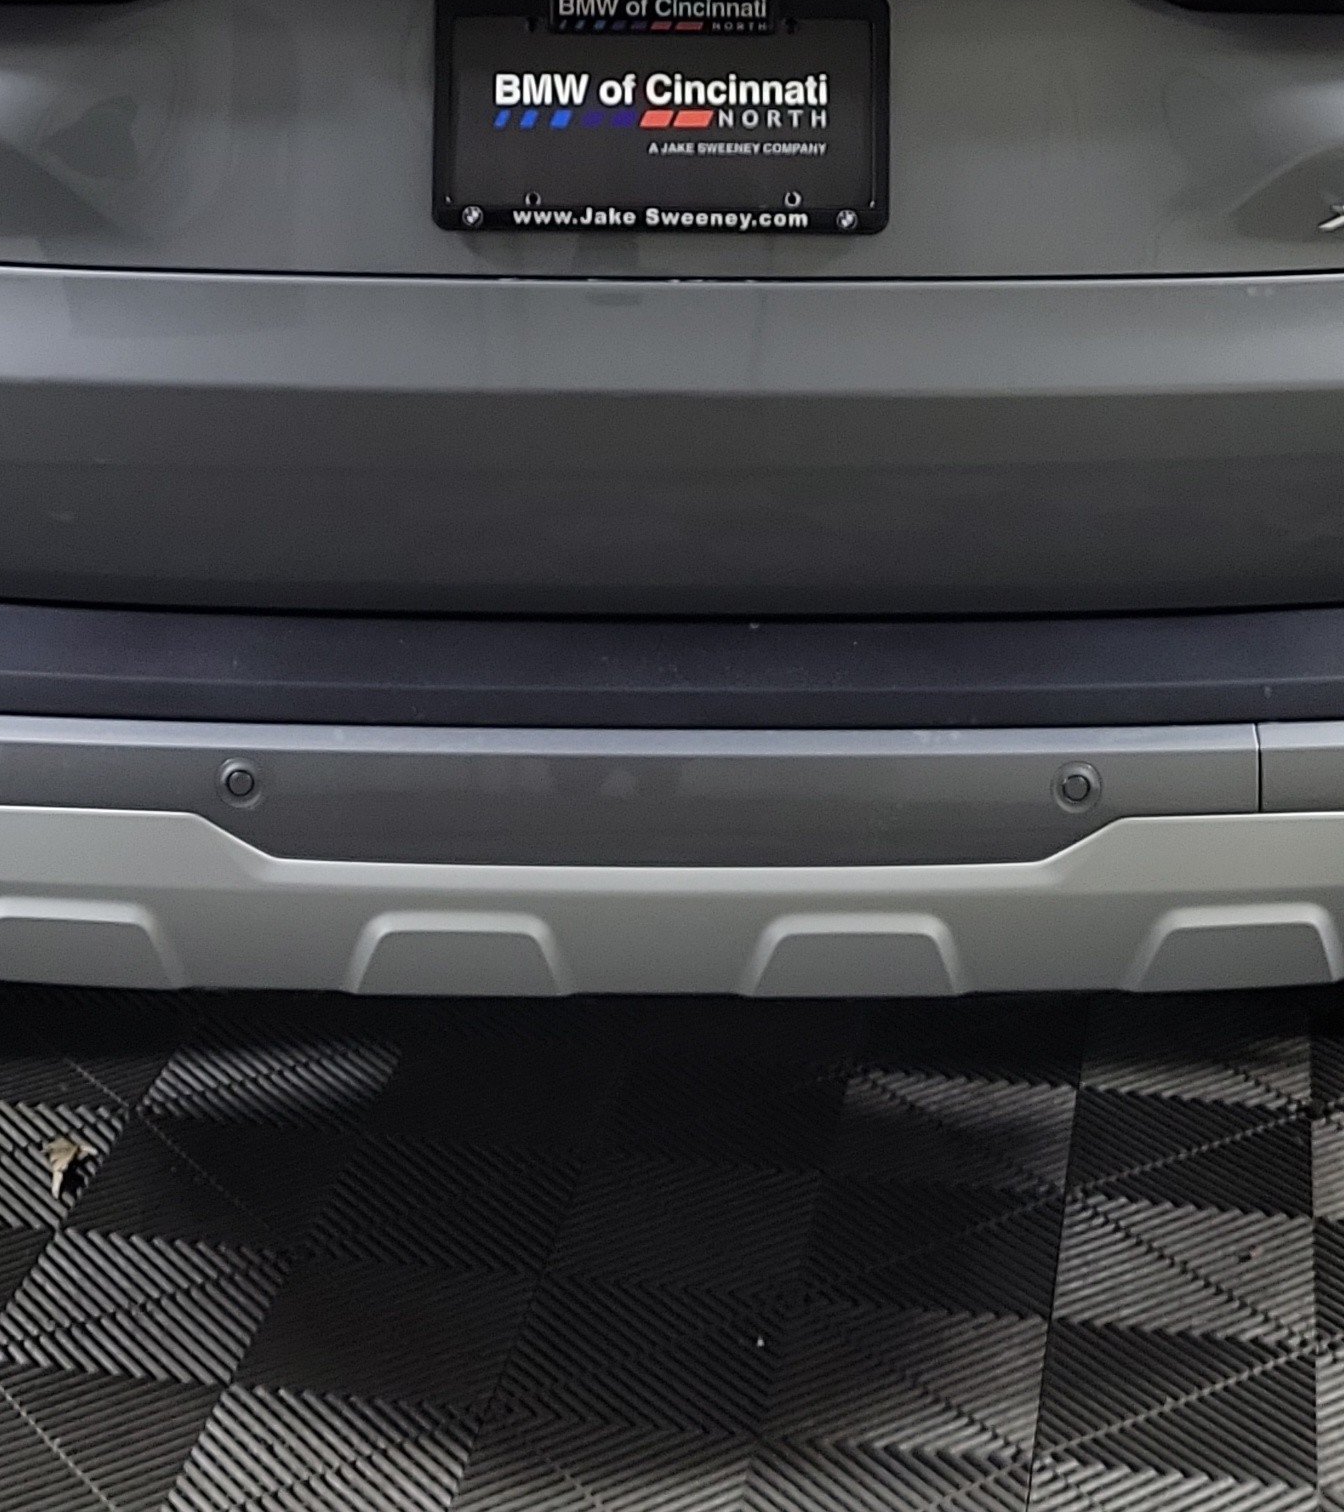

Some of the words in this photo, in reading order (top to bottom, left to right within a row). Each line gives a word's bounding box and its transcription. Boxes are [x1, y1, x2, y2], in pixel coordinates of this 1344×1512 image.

[494, 73, 588, 105] BMW
[598, 74, 637, 106] of
[645, 74, 829, 106] Cincinnati
[718, 109, 828, 129] NORTH
[648, 142, 658, 154] A
[661, 142, 695, 155] JAKE
[697, 142, 760, 155] SWEENEY
[762, 142, 827, 155] COMPANY
[512, 208, 636, 226] www.Jake
[645, 209, 809, 232] Sweeney.com
